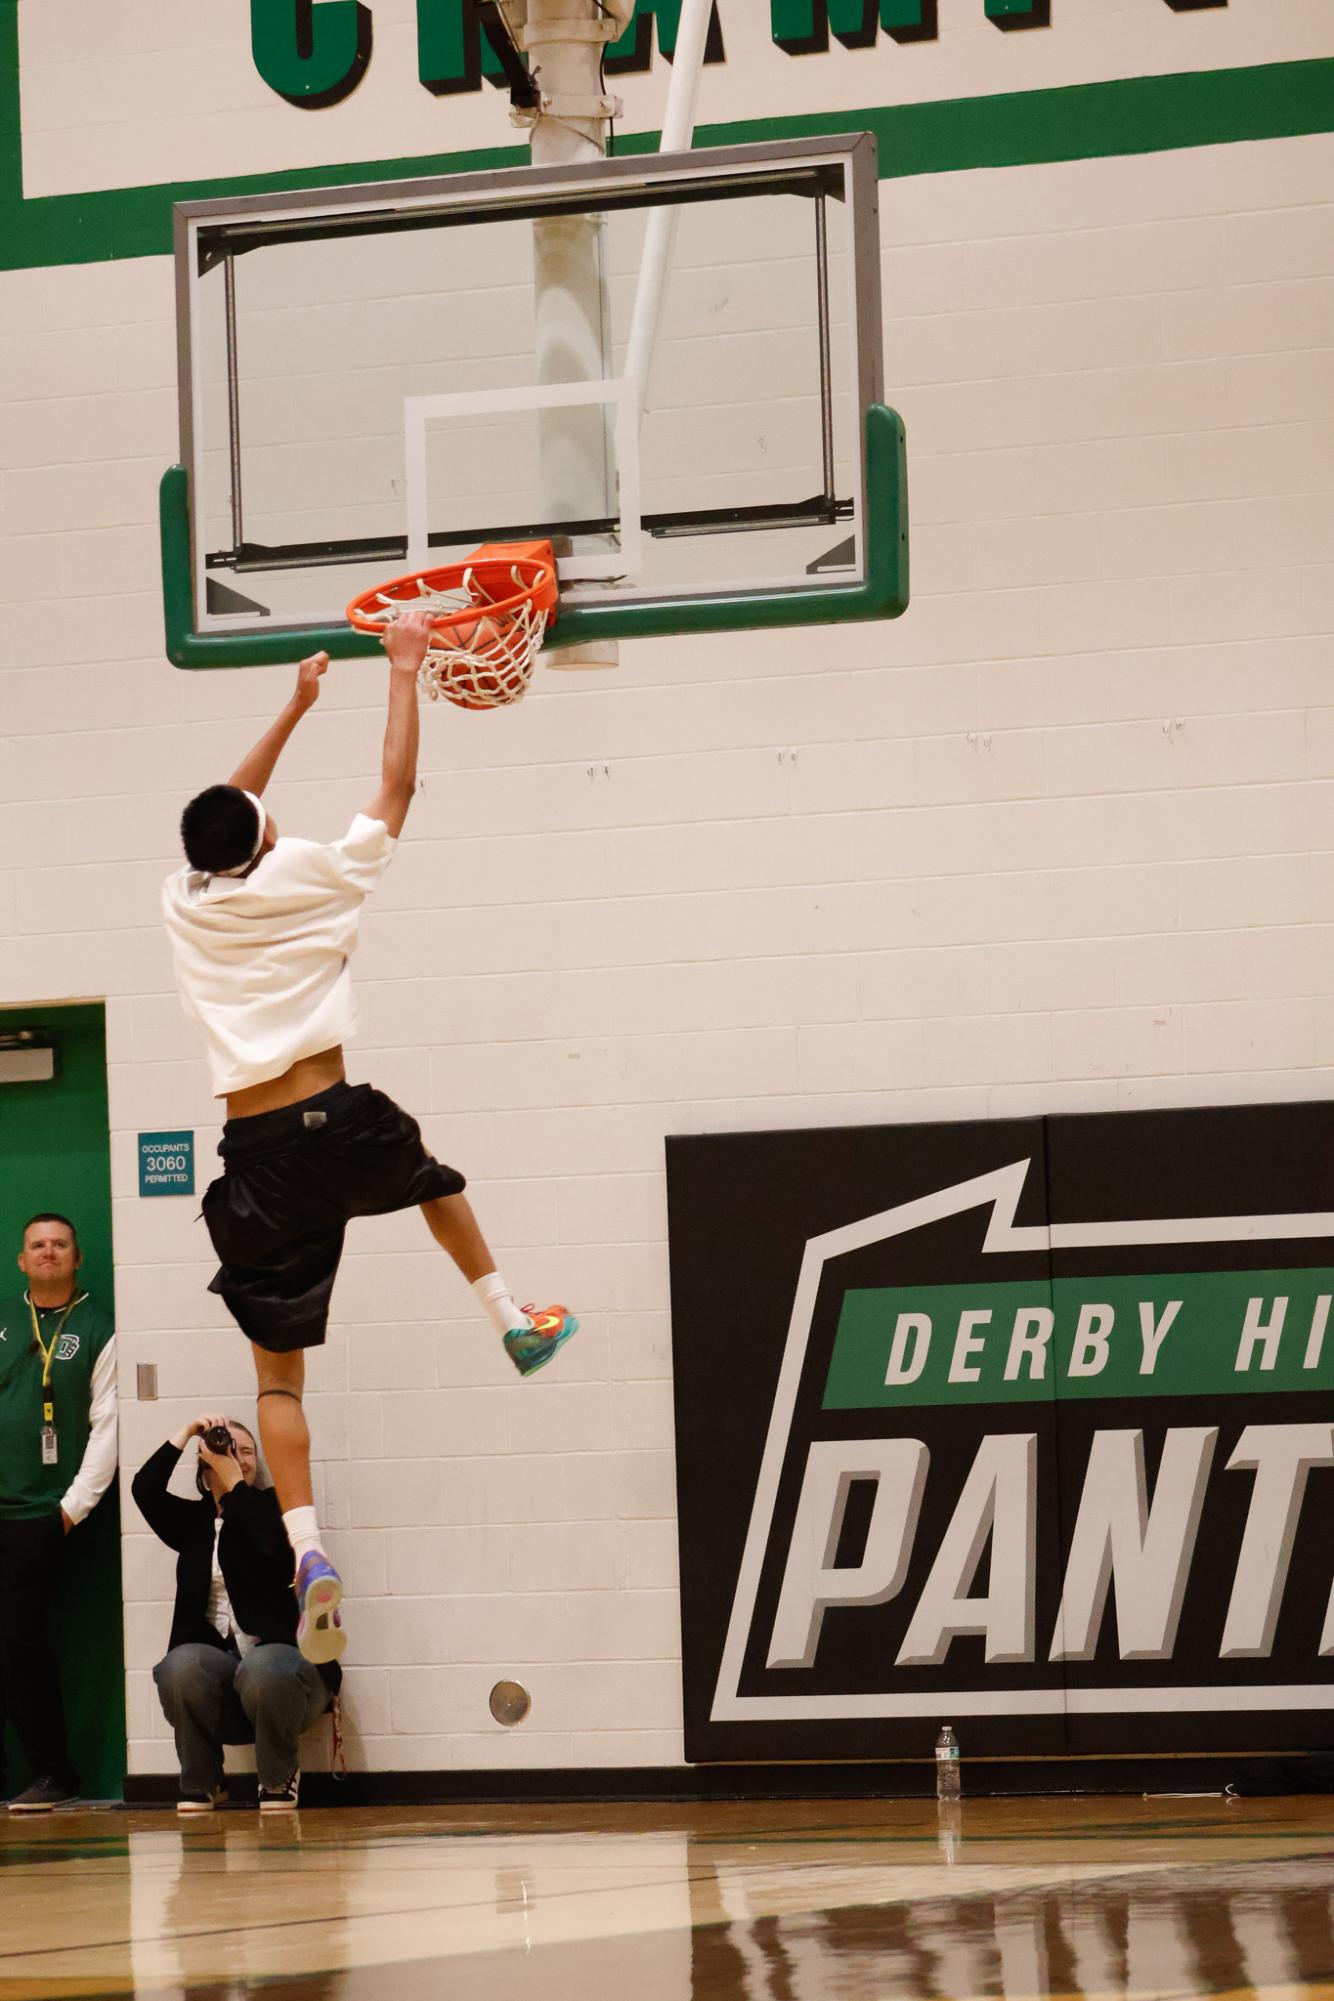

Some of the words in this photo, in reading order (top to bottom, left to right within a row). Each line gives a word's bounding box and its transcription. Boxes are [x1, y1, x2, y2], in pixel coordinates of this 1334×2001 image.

[142, 1143, 190, 1153] OCCUPANTS
[146, 1155, 186, 1171] 3060
[144, 1173, 188, 1183] PERMITTED
[884, 1301, 1183, 1386] DERBY
[1234, 1295, 1332, 1371] HI
[765, 1422, 1334, 1669] PANT
